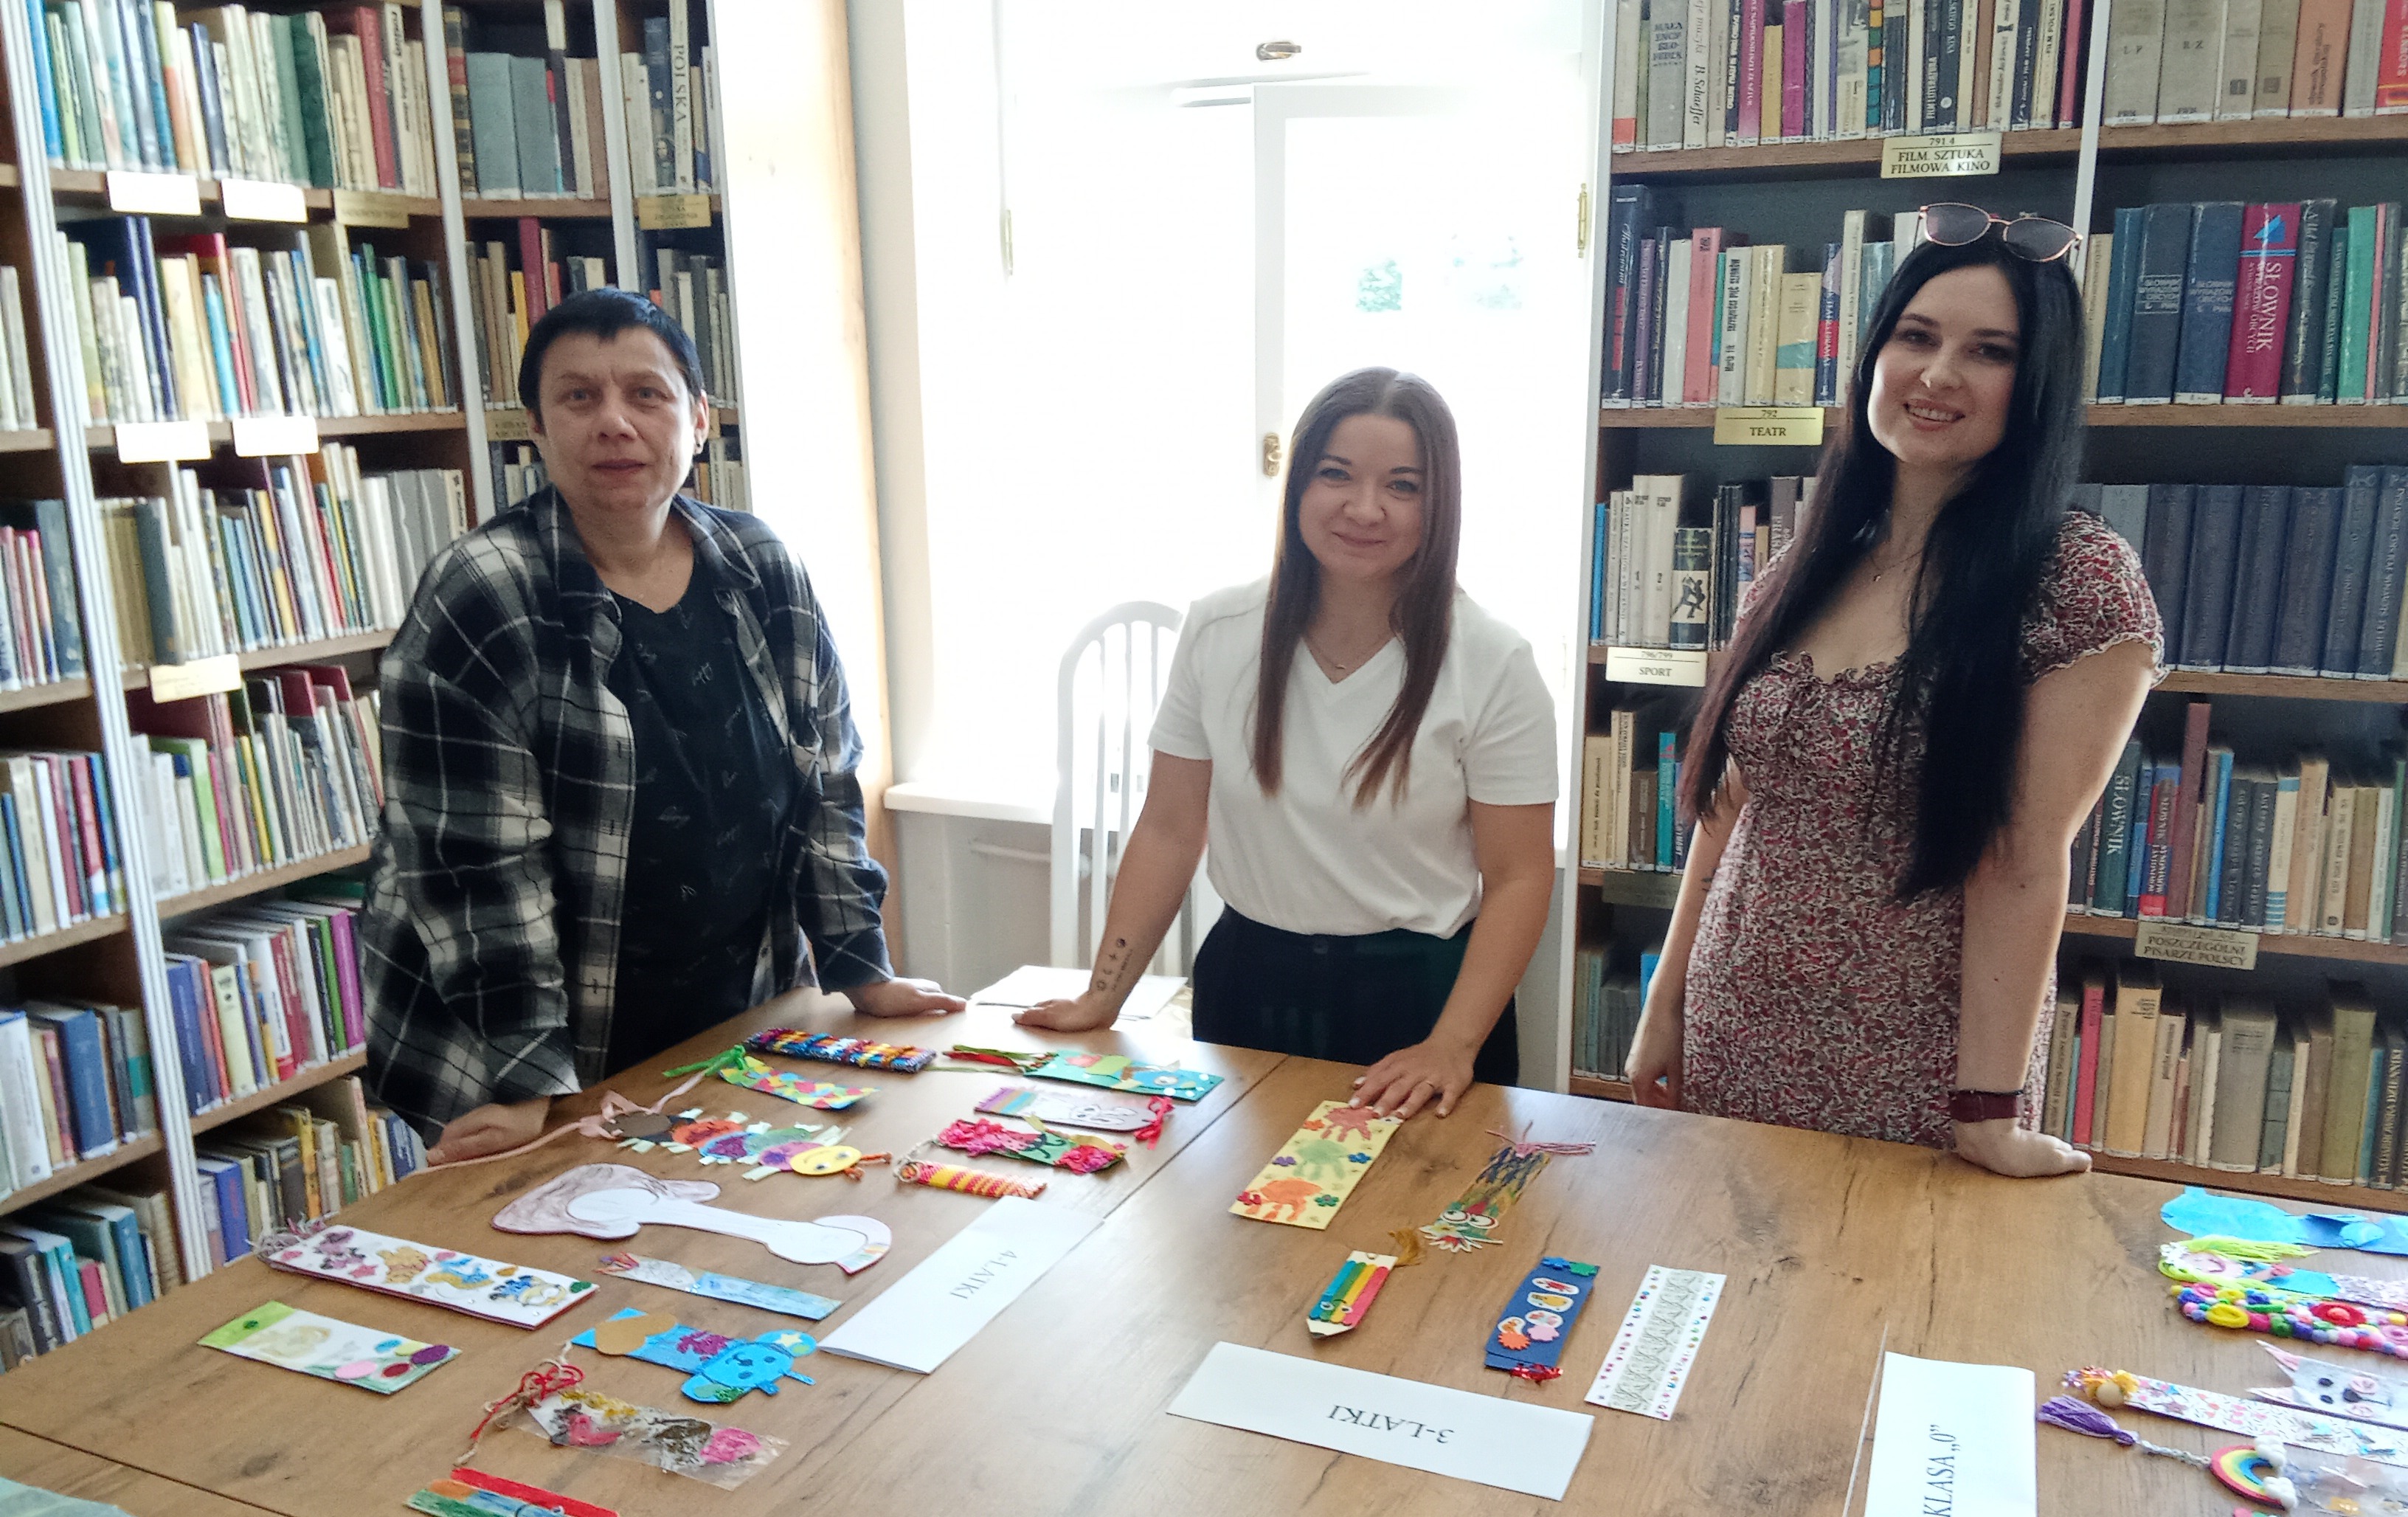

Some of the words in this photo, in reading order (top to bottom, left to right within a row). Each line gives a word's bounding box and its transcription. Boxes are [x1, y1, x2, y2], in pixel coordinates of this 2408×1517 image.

[674, 44, 688, 123] POLSKA
[1689, 74, 1706, 125] Schaeffer
[1934, 149, 1984, 160] SZTUKA
[1957, 160, 1990, 171] KINO
[2255, 262, 2283, 352] SŁOWNIK
[1749, 426, 1787, 437] TEATR
[1761, 410, 1778, 418] 792
[1639, 667, 1672, 677] SPORT
[2106, 775, 2131, 856] SŁOWNIK
[2143, 946, 2196, 961] PISARZE
[949, 1250, 1017, 1299] 4-LATKI
[1326, 1403, 1455, 1445] 3-LATKI
[1923, 1456, 1955, 1517] KLASA
